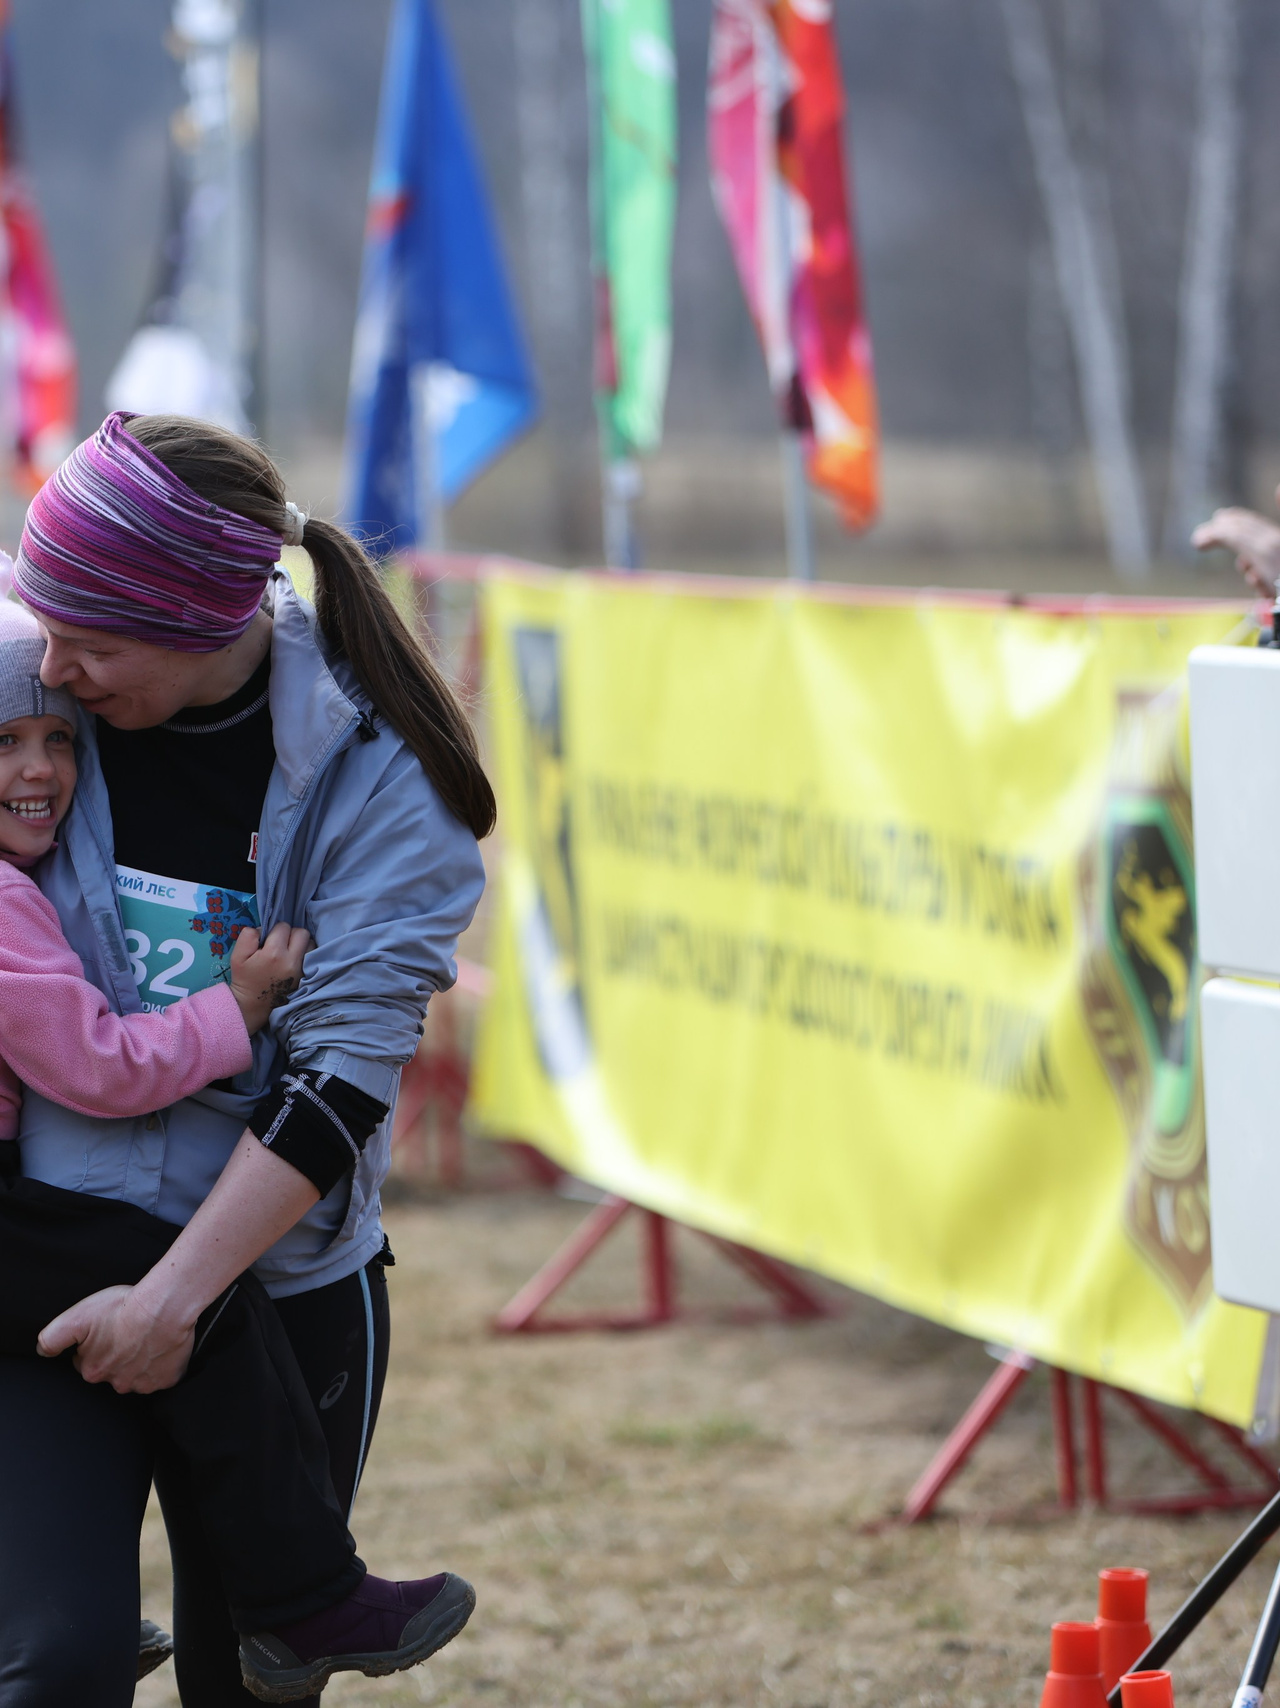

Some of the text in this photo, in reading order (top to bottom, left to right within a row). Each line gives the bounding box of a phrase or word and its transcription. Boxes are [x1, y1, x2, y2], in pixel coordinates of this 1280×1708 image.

[115, 873, 177, 899] КИЙ ЛЕС
[250, 1636, 281, 1665] QUECHUA
